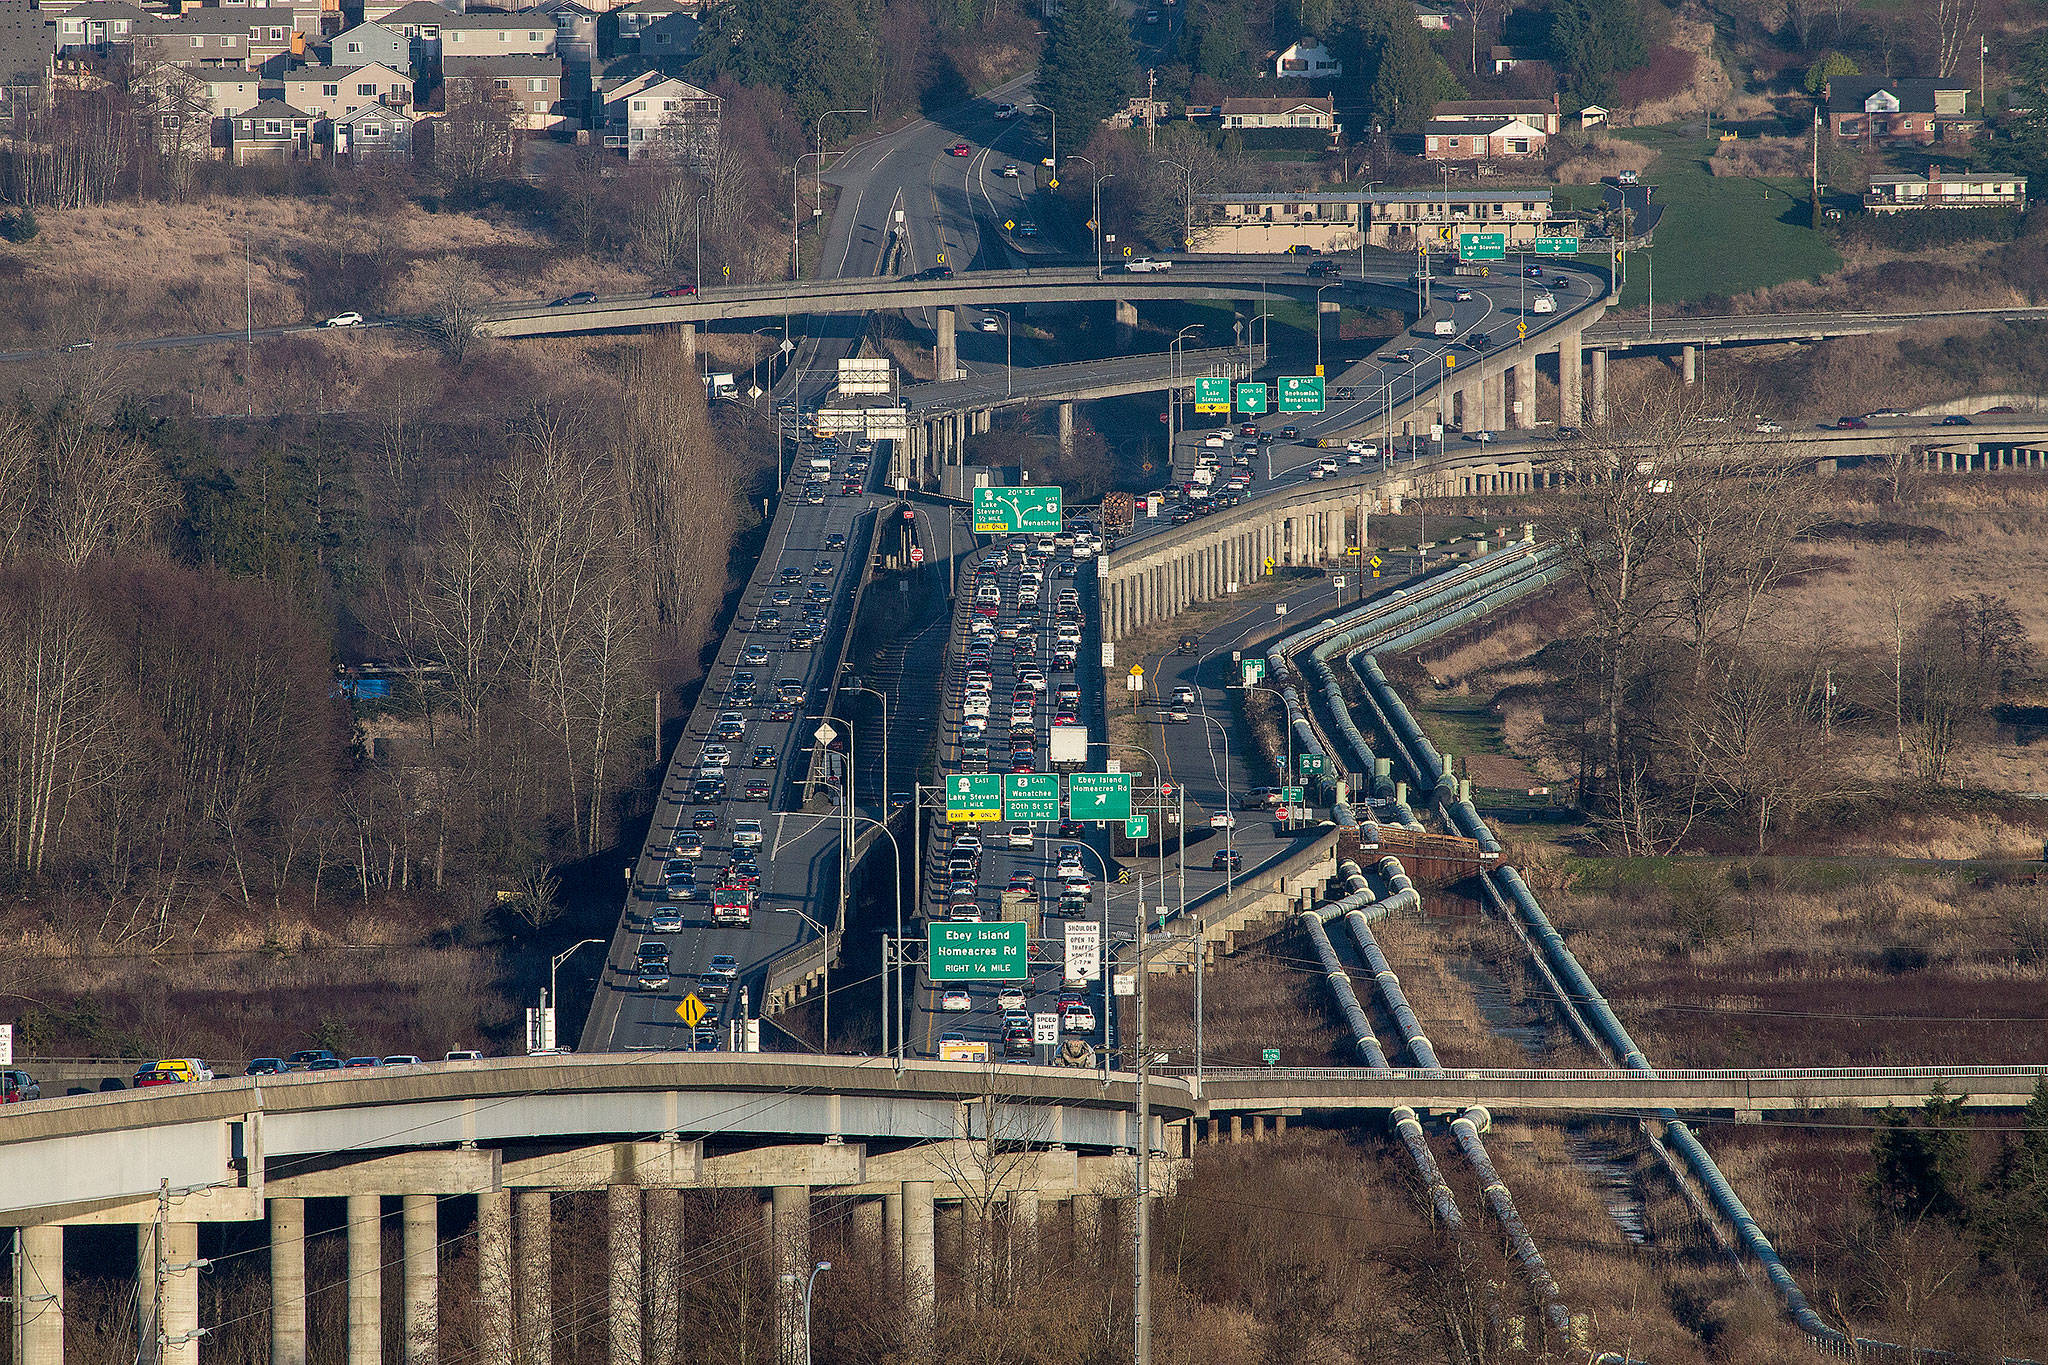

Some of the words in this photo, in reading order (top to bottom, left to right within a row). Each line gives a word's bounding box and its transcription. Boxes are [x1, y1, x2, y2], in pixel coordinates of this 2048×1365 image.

[1049, 504, 1055, 512] 2
[1078, 776, 1096, 784] Ebey
[1010, 802, 1029, 810] 20th
[1032, 802, 1041, 810] St
[1043, 802, 1054, 810] SE
[1067, 924, 1098, 932] SHOULDER
[946, 931, 972, 942] Ebey
[978, 931, 1010, 940] Island
[938, 946, 997, 956] Homeacres
[1003, 946, 1017, 956] Rd
[945, 964, 970, 972] RIGHT
[990, 964, 1011, 972] MILE
[1037, 1032, 1055, 1041] 55
